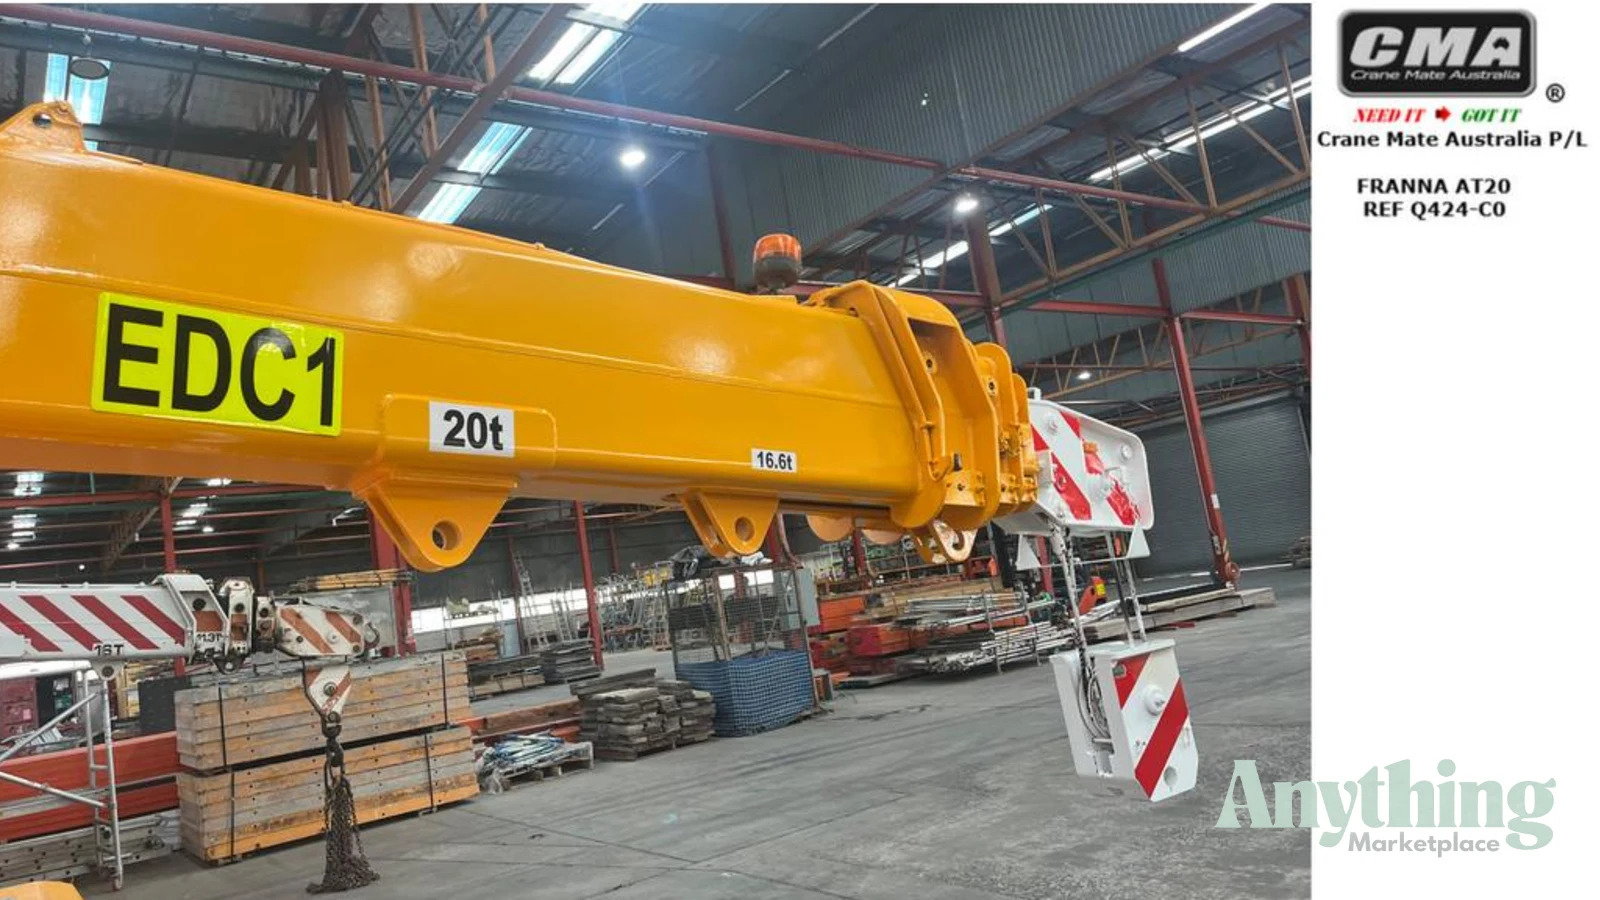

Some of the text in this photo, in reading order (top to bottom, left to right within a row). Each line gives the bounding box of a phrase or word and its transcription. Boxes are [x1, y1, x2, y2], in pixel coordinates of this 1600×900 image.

[102, 303, 336, 427] EDC1
[443, 409, 504, 451] 20t
[757, 451, 793, 471] 16.6t
